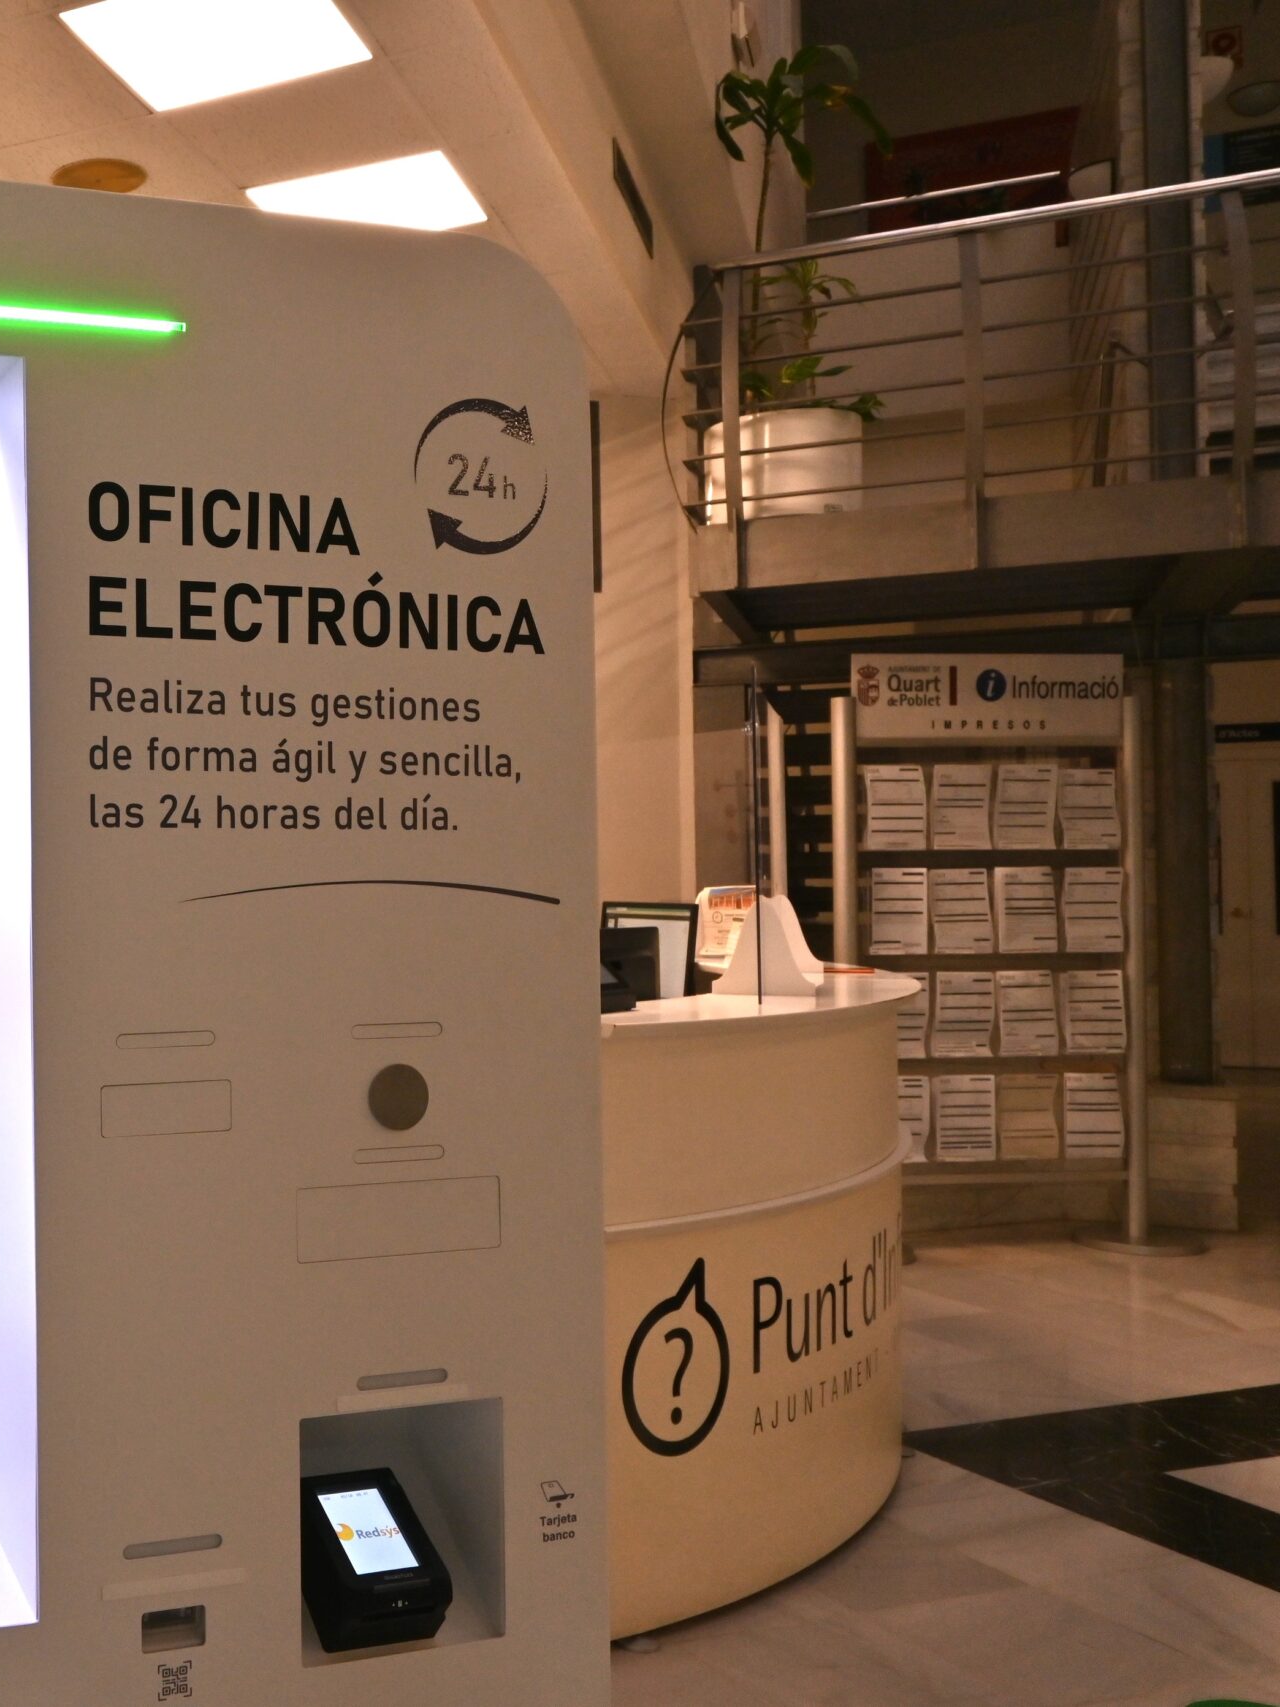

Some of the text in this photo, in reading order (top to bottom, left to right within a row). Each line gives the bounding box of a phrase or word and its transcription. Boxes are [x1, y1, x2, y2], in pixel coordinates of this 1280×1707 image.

[88, 481, 361, 556] OFICINA
[89, 571, 545, 654] ELECTRÓNICA
[887, 674, 941, 693] Quart
[1012, 675, 1119, 700] Informació
[90, 677, 480, 727] Realiza tus gestiones
[887, 693, 941, 707] de Poblet
[931, 719, 1046, 731] IMPRESOS
[89, 736, 522, 784] de forma ágil y sencilla,
[90, 794, 458, 831] las 24 horas del día.
[753, 1259, 854, 1374] Punt
[356, 1526, 401, 1540] Redsys
[540, 1513, 577, 1529] Tarjeta
[542, 1529, 576, 1543] banco
